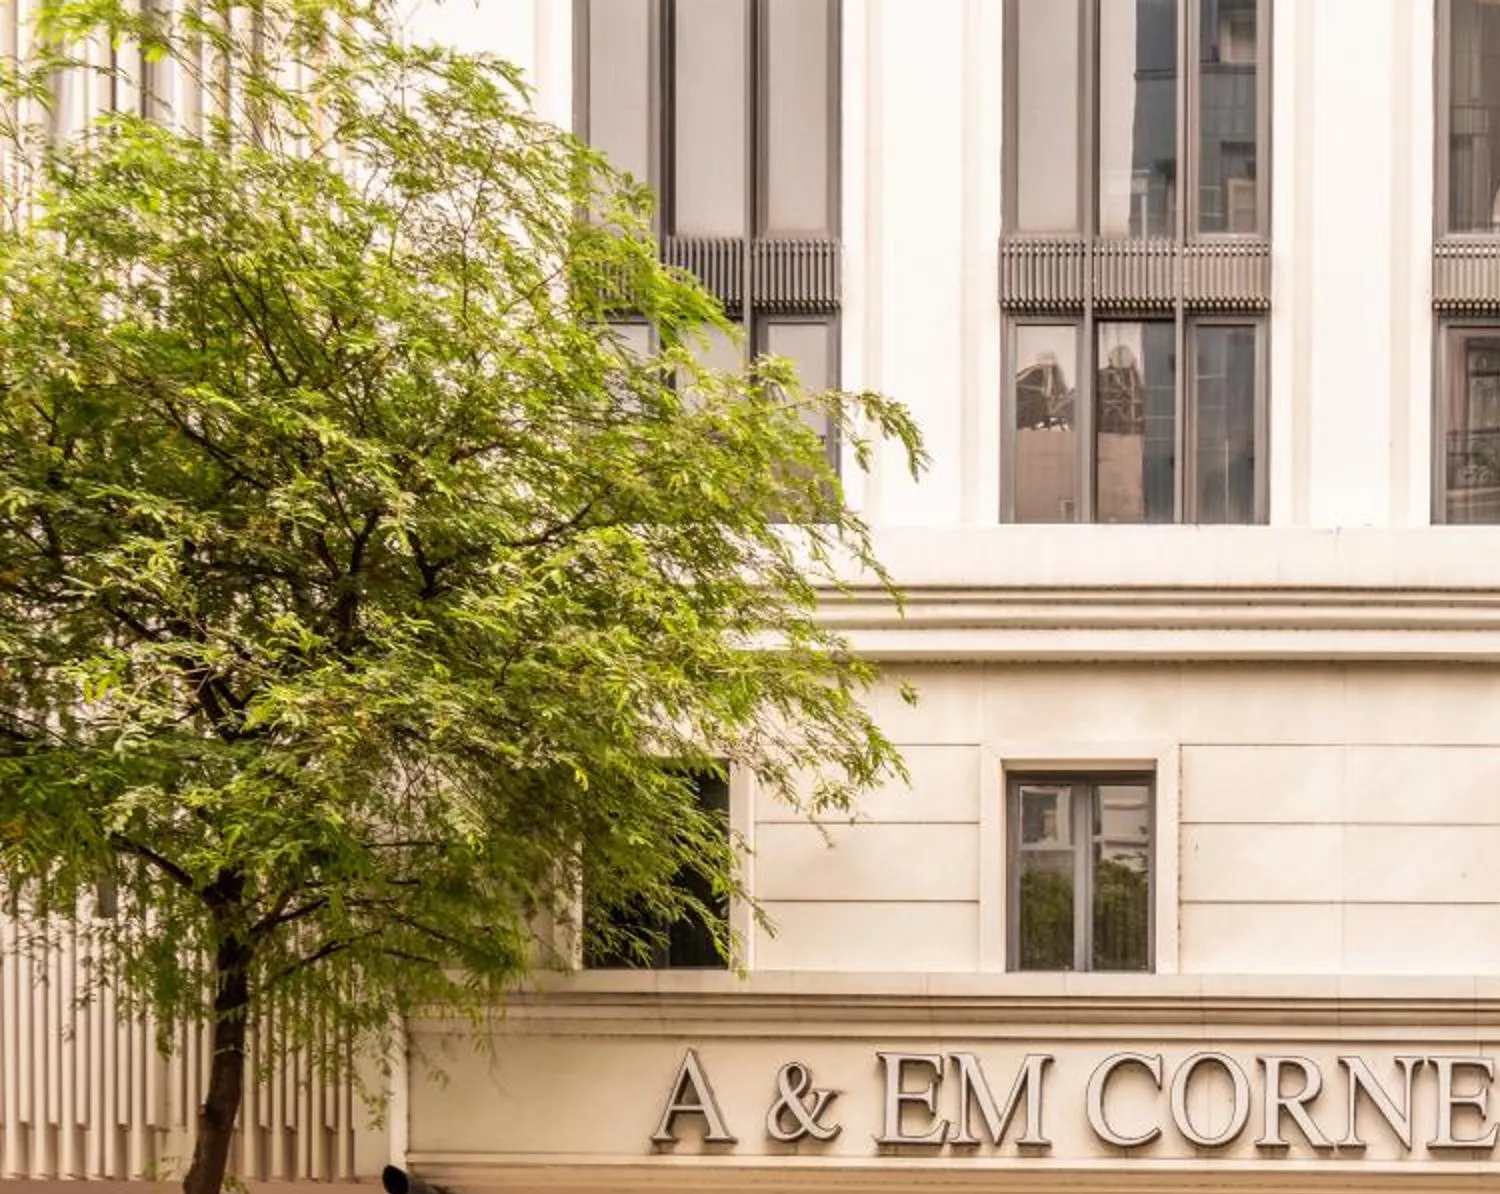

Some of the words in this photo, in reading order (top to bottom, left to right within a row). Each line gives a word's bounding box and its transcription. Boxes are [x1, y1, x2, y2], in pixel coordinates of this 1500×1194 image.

[650, 1048, 738, 1145] A
[766, 1061, 844, 1143] &
[873, 1052, 1055, 1147] EM
